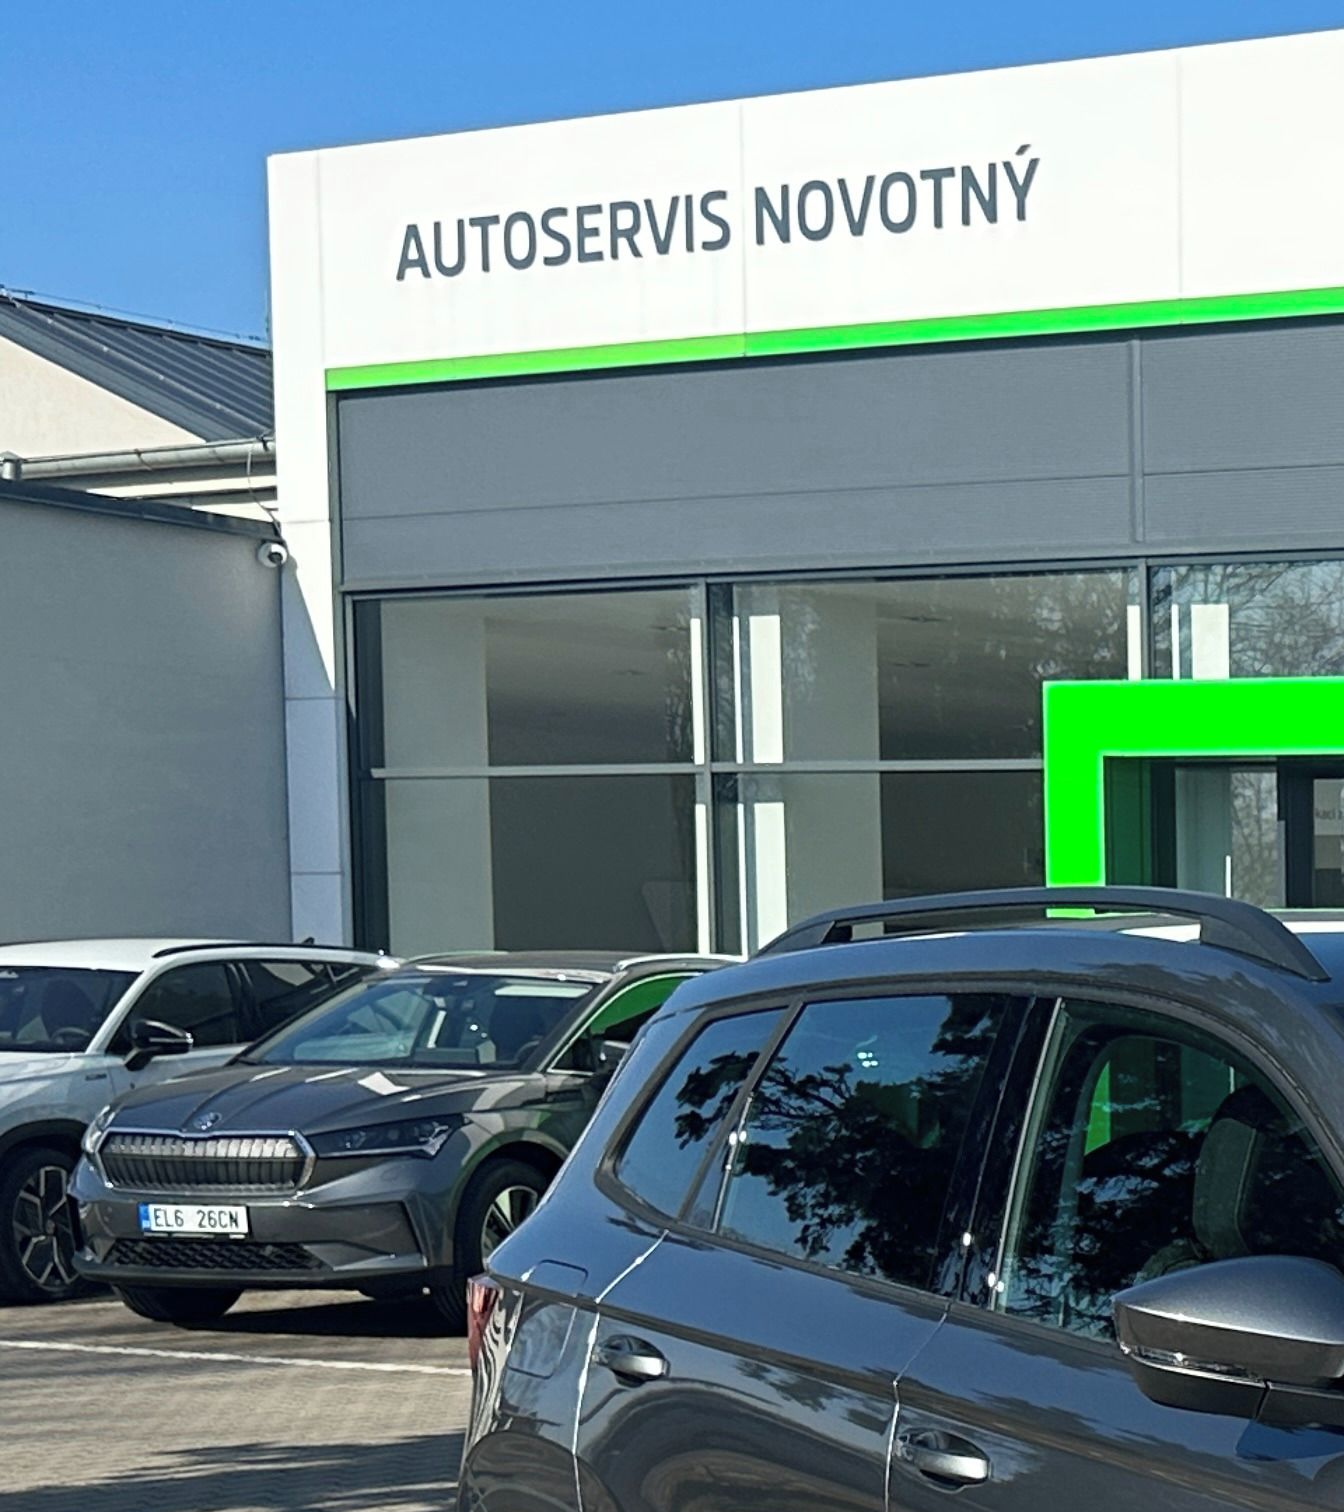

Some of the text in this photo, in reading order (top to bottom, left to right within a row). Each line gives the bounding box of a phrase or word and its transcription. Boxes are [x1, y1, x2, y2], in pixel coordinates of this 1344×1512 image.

[396, 143, 1041, 282] AUTOSERVIS NOVOTNÝ
[153, 1207, 240, 1229] EL6 26CN
